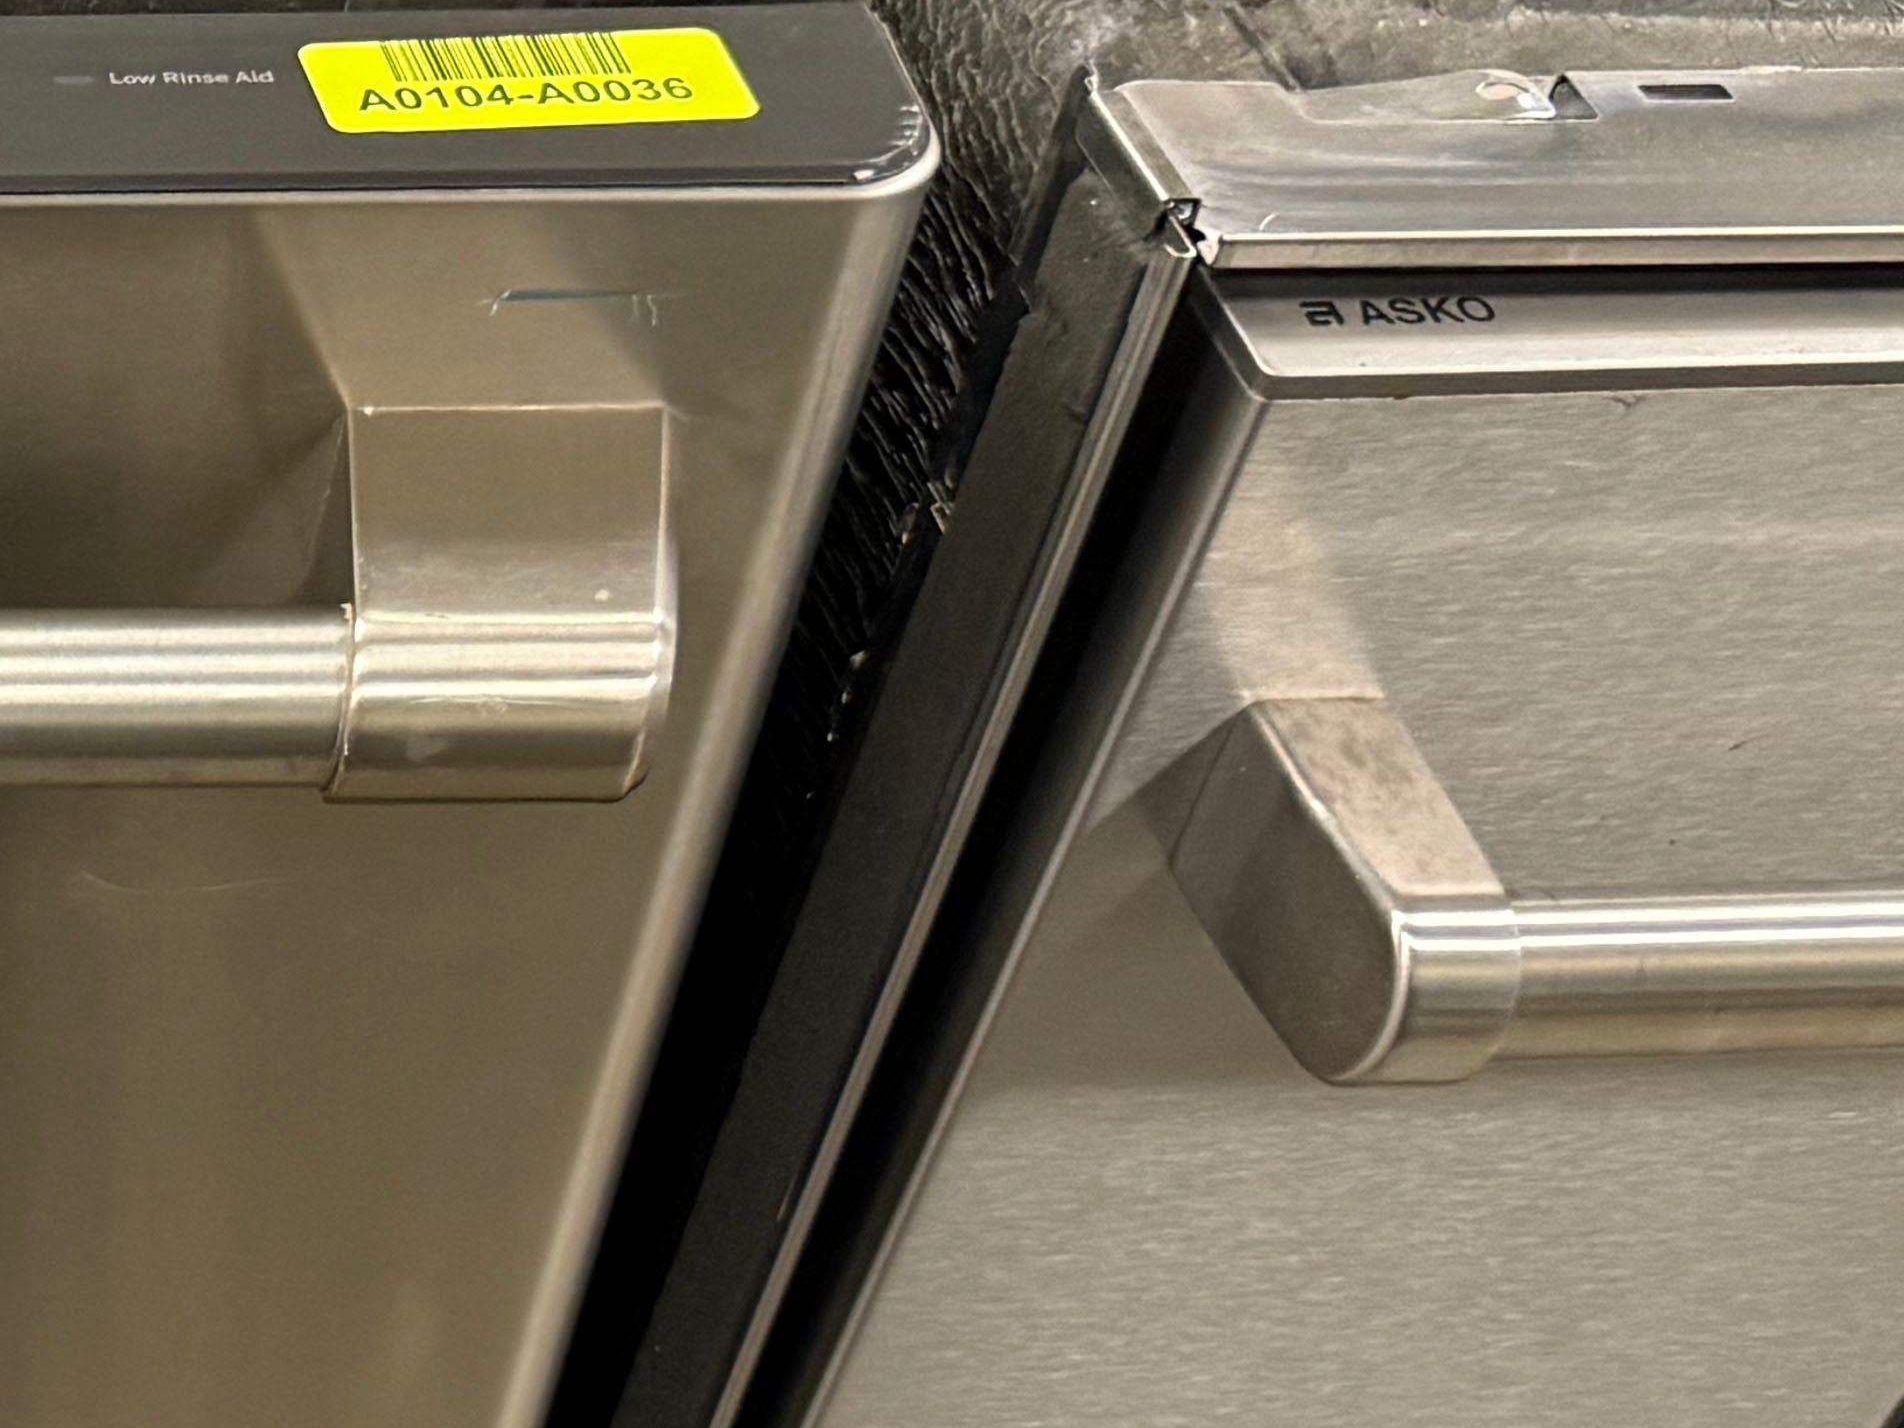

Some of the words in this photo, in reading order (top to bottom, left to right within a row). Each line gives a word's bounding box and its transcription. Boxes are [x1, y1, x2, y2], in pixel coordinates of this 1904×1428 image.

[109, 72, 156, 85] Low
[163, 71, 229, 84] Rinse
[359, 76, 693, 112] A0104-A0036
[1359, 296, 1496, 326] ASKO
